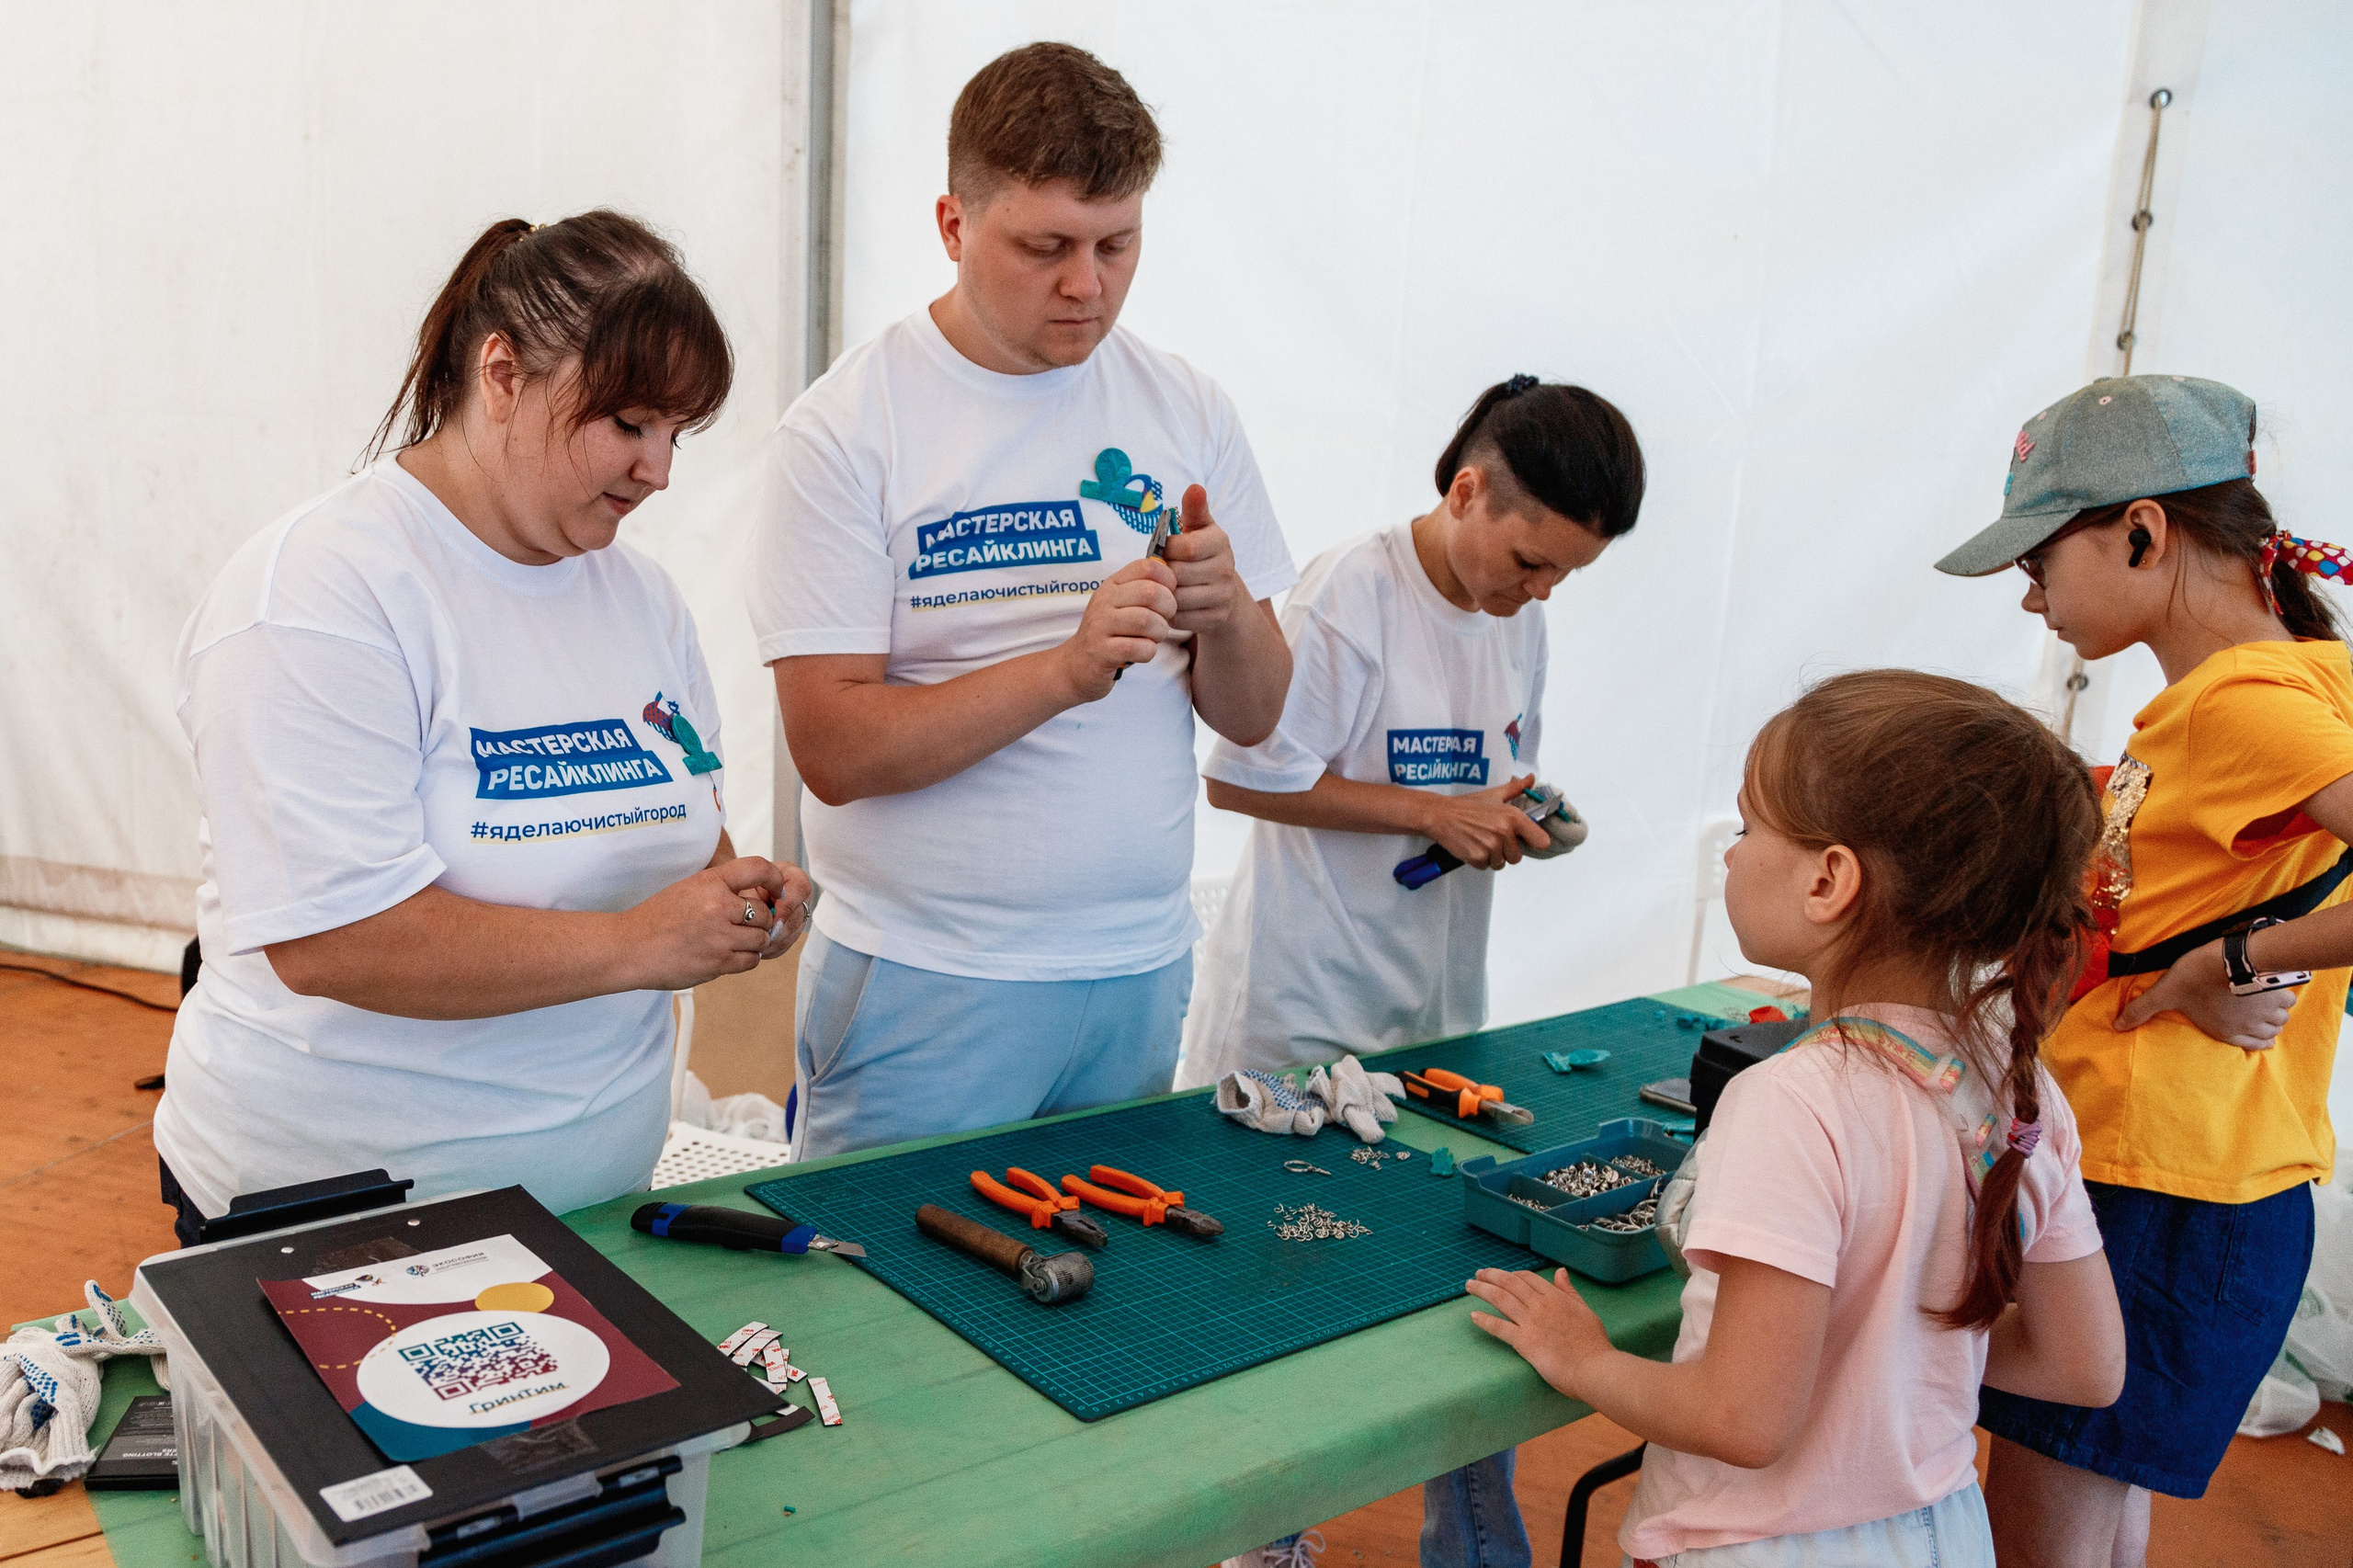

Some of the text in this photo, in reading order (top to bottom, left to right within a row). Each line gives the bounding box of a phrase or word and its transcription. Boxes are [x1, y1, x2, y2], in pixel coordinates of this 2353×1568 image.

[925, 508, 1076, 550] МАСТЕРСКАЯ
[915, 539, 1094, 572] РЕСАЙКЛИНГА
[910, 579, 1104, 608] #яделаючистыйгоро
[475, 728, 632, 758] МАСТЕРСКАЯ
[487, 757, 663, 790] РЕСАЙКЛИНГА
[471, 804, 687, 841] #яделаючистыйгород
[431, 1252, 484, 1267] ЭКОСОФИЯ
[469, 1382, 565, 1413] ГринТим
